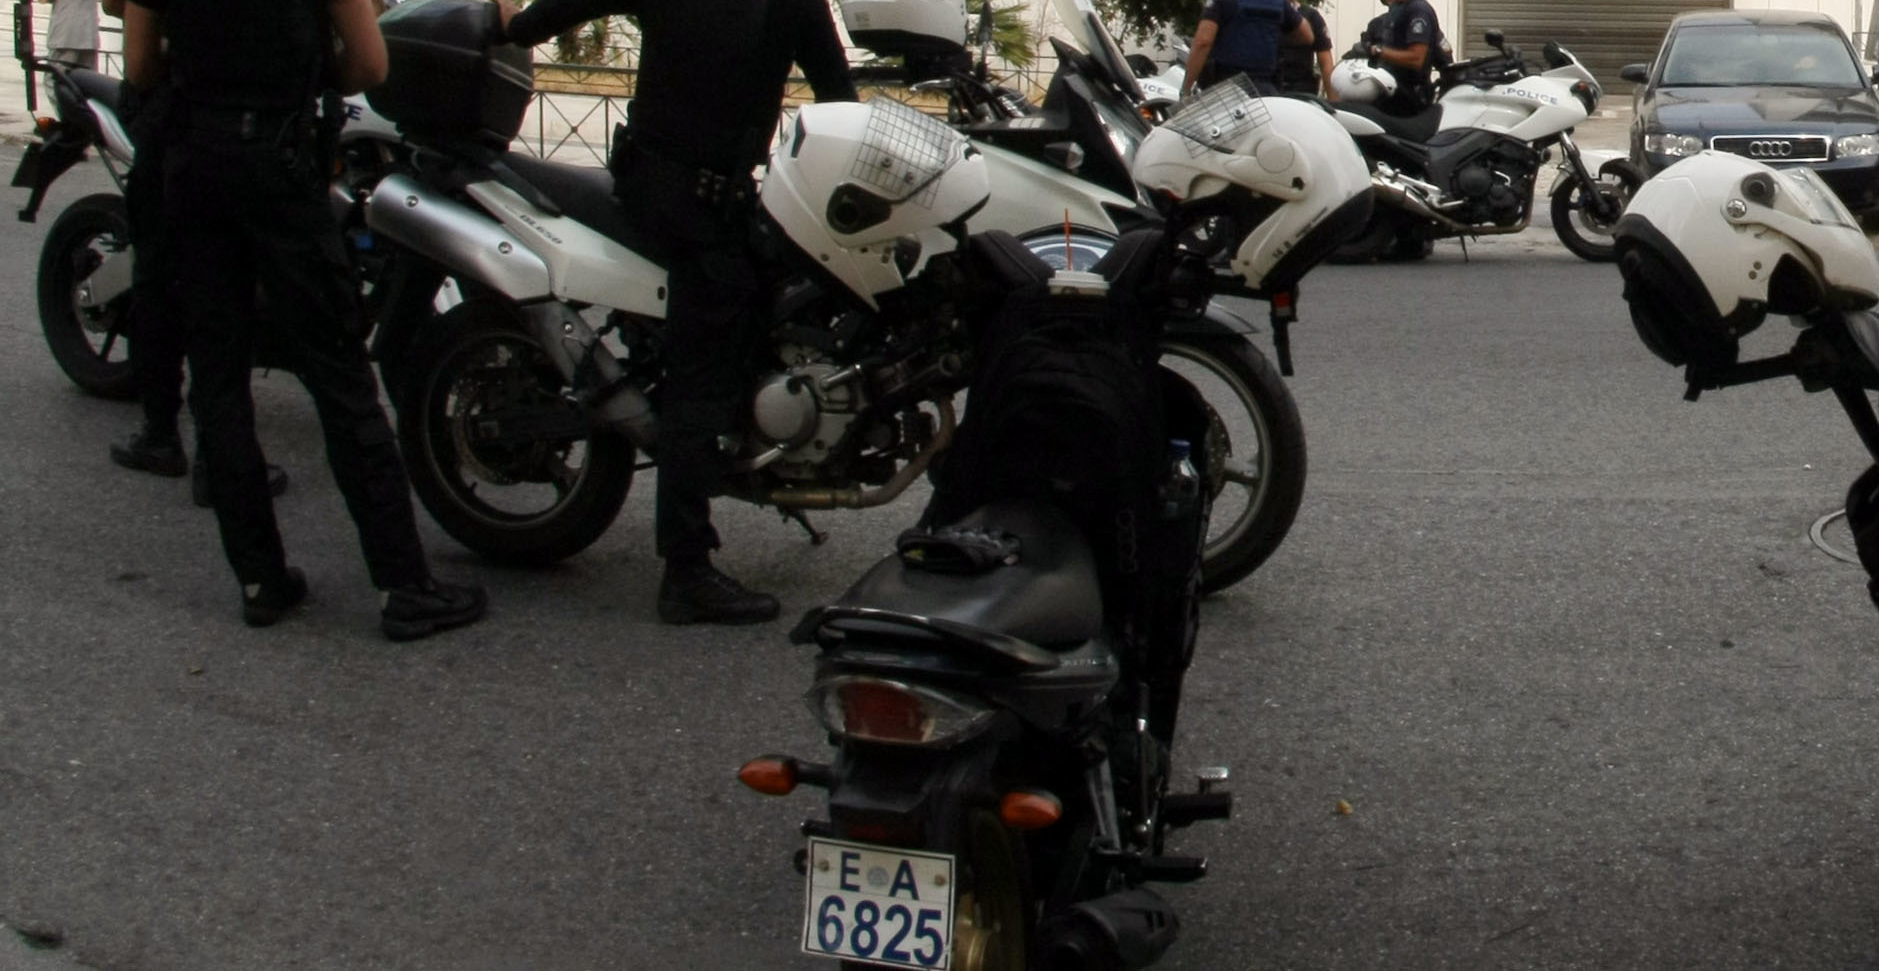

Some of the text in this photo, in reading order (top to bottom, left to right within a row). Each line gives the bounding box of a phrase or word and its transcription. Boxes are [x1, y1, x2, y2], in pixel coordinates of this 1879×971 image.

[1507, 87, 1558, 105] POLICE
[840, 851, 920, 900] E A
[817, 895, 944, 966] 6825
